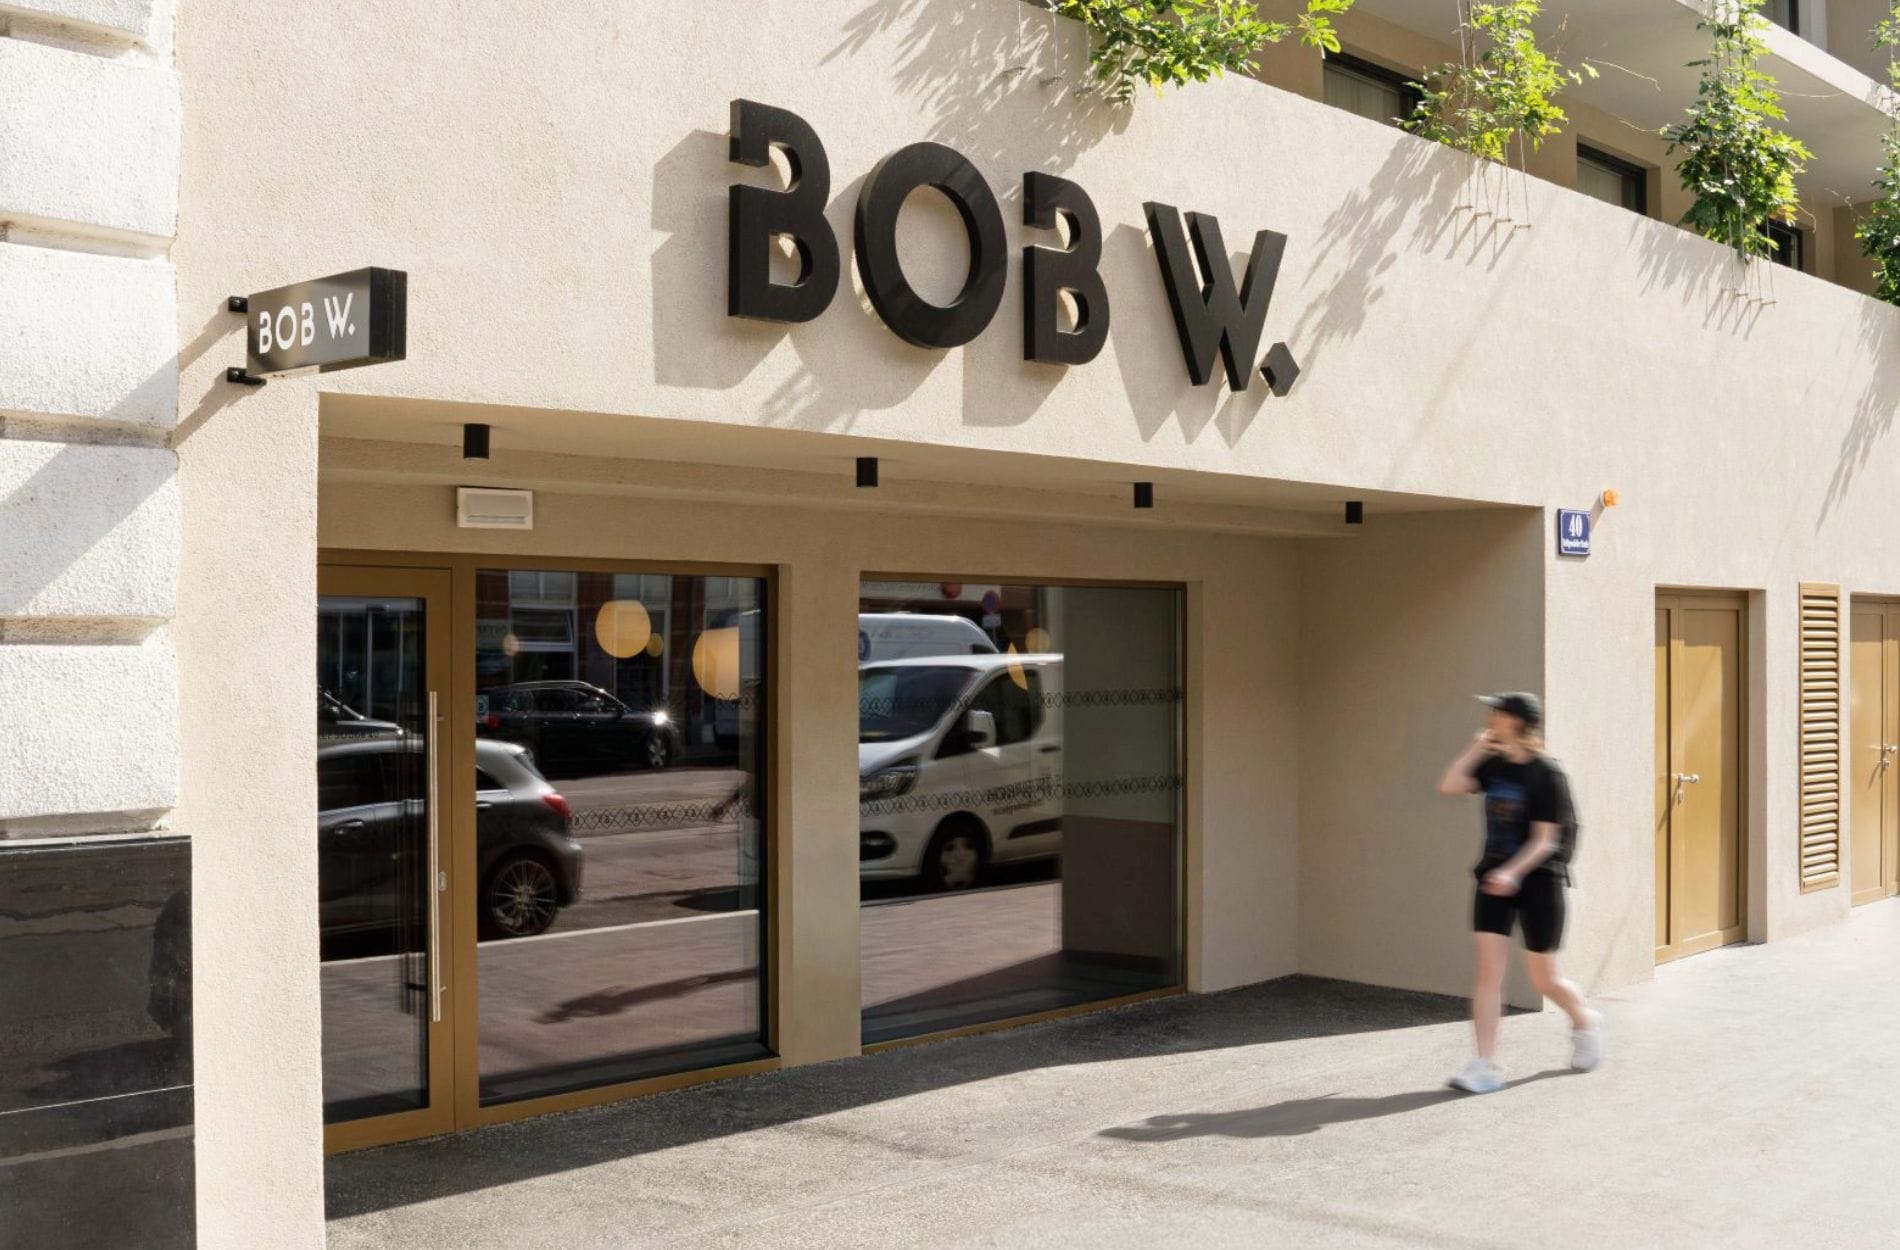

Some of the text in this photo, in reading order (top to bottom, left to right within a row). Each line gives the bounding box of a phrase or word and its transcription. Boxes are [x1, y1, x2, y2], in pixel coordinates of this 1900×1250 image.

[728, 98, 1300, 397] BOB W.
[258, 292, 356, 354] BOB W.
[1568, 514, 1583, 538] 40
